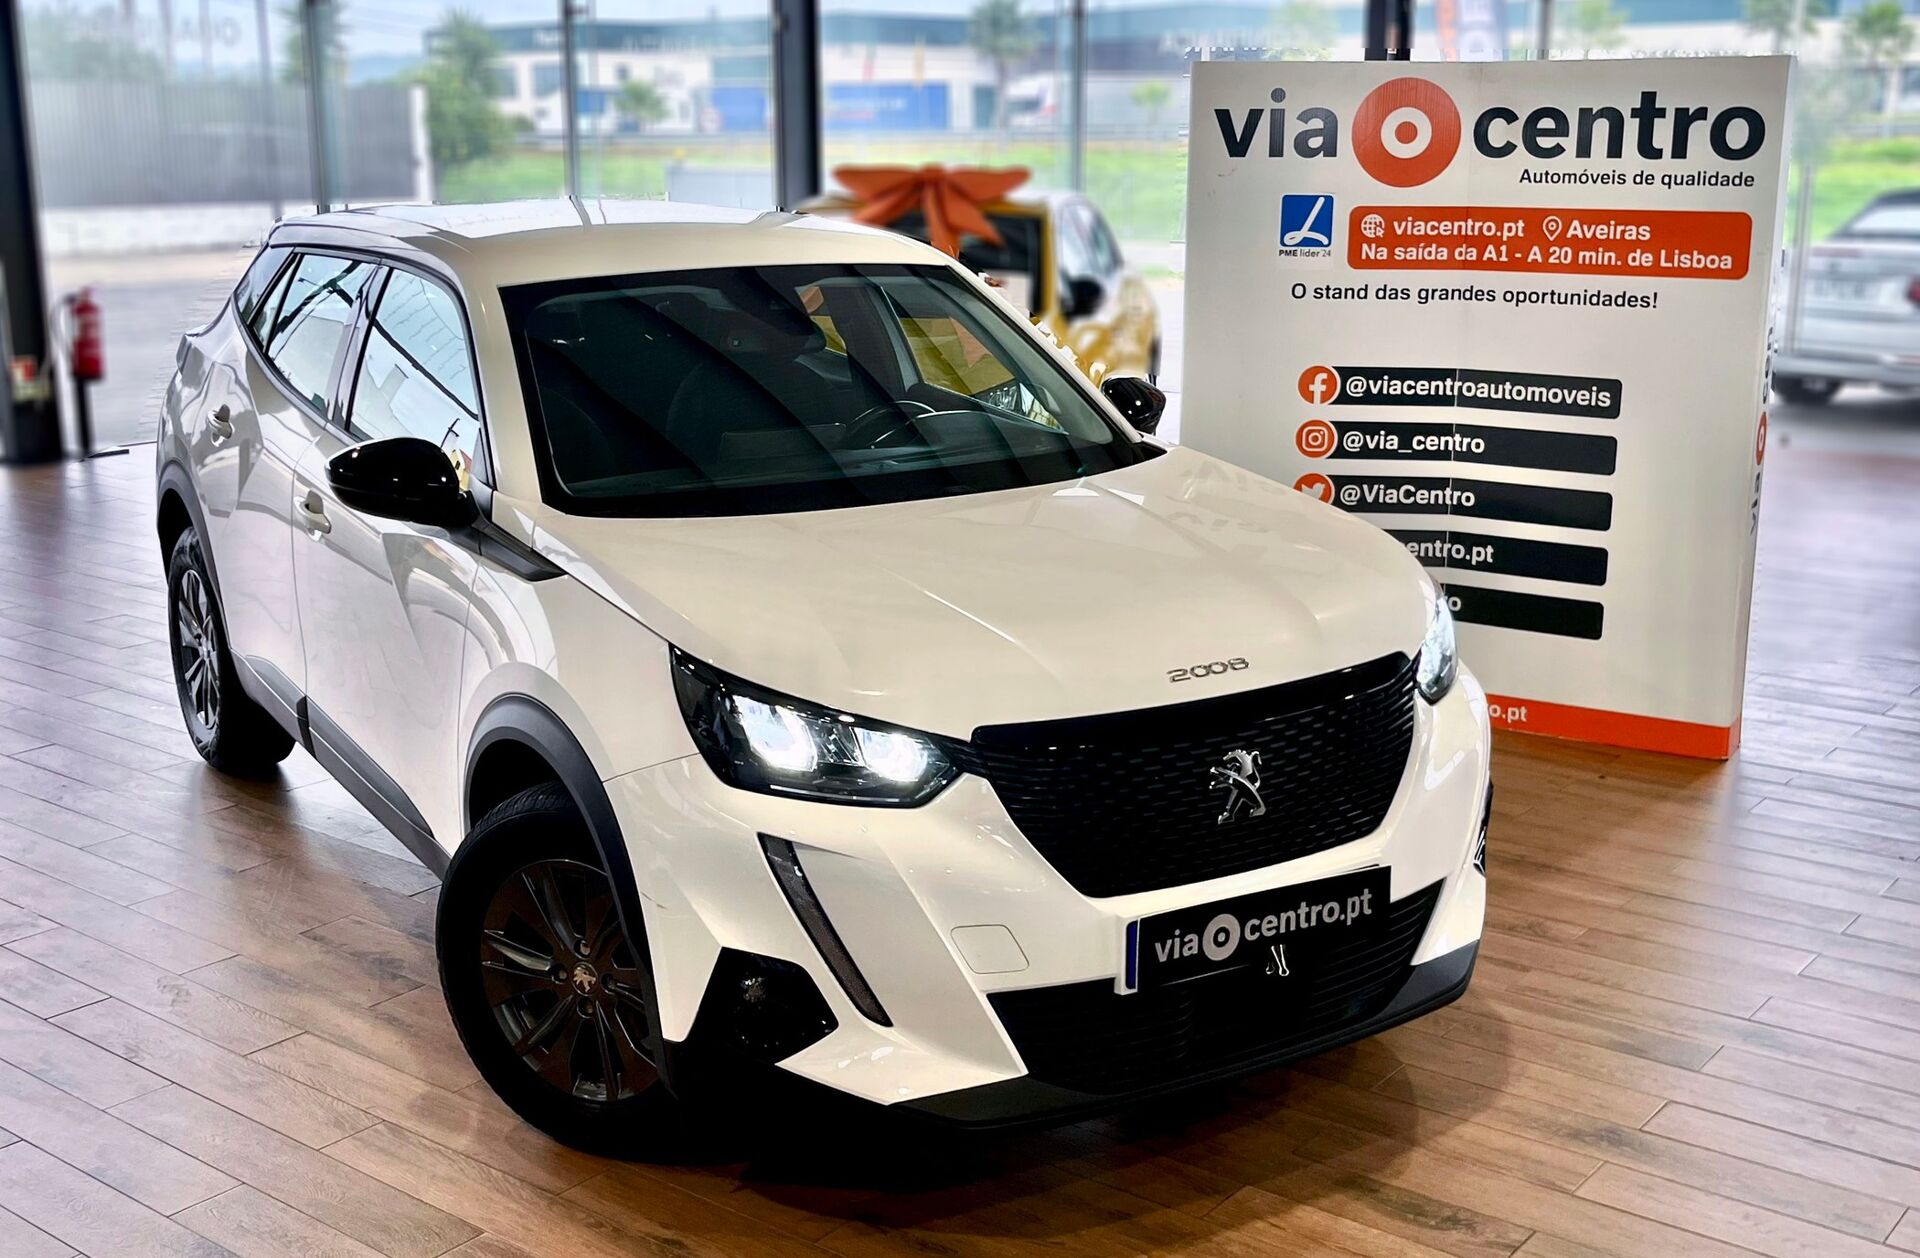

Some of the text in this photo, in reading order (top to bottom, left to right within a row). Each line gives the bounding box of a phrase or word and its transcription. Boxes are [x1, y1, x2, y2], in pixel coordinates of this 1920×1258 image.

[1214, 88, 1766, 161] via centro
[1519, 167, 1755, 190] Automóveis de qualidade
[1393, 216, 1651, 241] viacentro.pt Aveiras
[1278, 249, 1298, 257] PME
[1361, 243, 1388, 261] Na
[1394, 243, 1448, 261] saída
[1454, 244, 1477, 261] da
[1482, 245, 1509, 262] A1
[1527, 246, 1543, 263] A
[1548, 246, 1572, 265] 20
[1579, 248, 1622, 266] min.
[1628, 248, 1653, 267] de
[1660, 249, 1732, 269] Lisboa
[1291, 282, 1658, 309] O stand das grandes oportunidades!
[1346, 374, 1612, 408] @viacentroautomoveis
[1342, 430, 1485, 454] @via_centro
[1339, 483, 1476, 508] @ViaCentro
[1405, 539, 1495, 566] entro.pt
[1167, 657, 1250, 683] 2008
[1488, 703, 1528, 724] o.pt
[1154, 887, 1373, 964] via centro.pt
